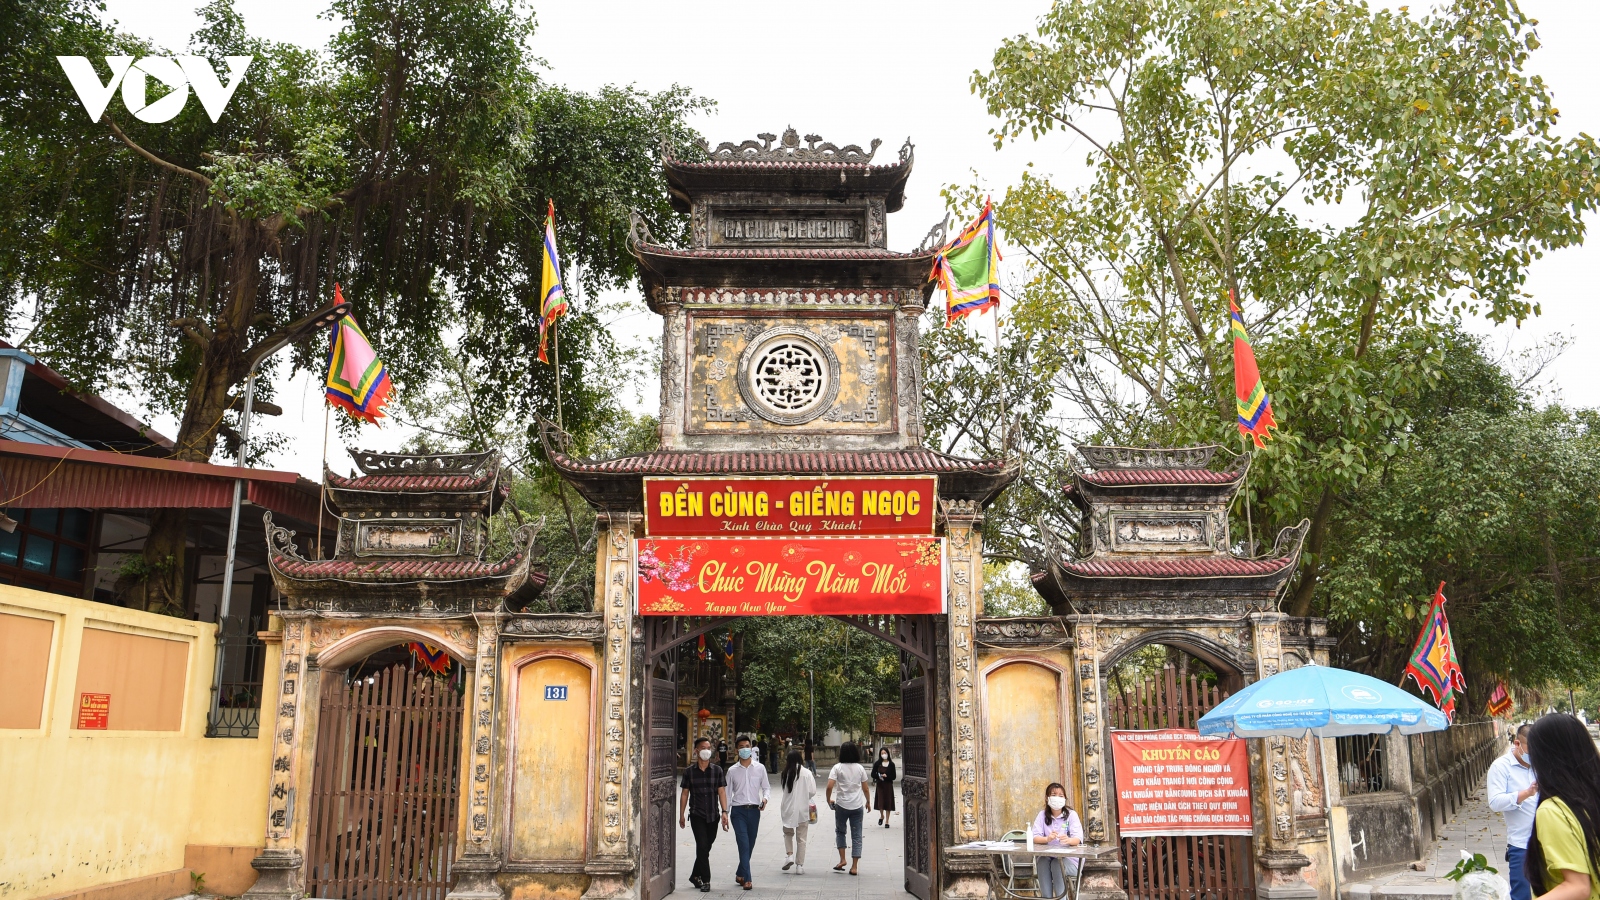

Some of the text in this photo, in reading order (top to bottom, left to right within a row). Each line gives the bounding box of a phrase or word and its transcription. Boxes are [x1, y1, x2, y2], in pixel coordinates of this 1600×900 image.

[660, 483, 703, 517] ĐỀN
[710, 486, 769, 517] CÙNG
[789, 482, 855, 516] GIẾNG
[862, 490, 921, 522] NGỌC
[720, 520, 863, 533] Kính Chào Quý Khách!
[699, 560, 911, 602] Chúc Mừng Năm Mới
[705, 602, 787, 613] Happy New Year
[546, 687, 566, 699] 131
[1141, 744, 1221, 761] KHUYẾN CÁO
[1132, 764, 1153, 774] KHÔNG
[1153, 764, 1165, 775] TẬP
[1184, 763, 1202, 773] ĐÔNG
[1133, 777, 1145, 786] ĐEO
[1198, 775, 1215, 785] CÔNG
[1216, 776, 1234, 787] CỘNG
[1198, 789, 1212, 799] DỊCH
[1213, 788, 1226, 798] SÁT
[1133, 802, 1148, 812] THỰC
[1148, 801, 1163, 812] HIỆN
[1192, 802, 1208, 810] THEO
[1209, 802, 1221, 810] QUY
[1222, 802, 1238, 811] ĐỊNH
[1153, 814, 1167, 823] CÔNG
[1168, 813, 1178, 823] TÁC
[1193, 812, 1211, 823] CHỐNG
[1211, 814, 1224, 824] DỊCH
